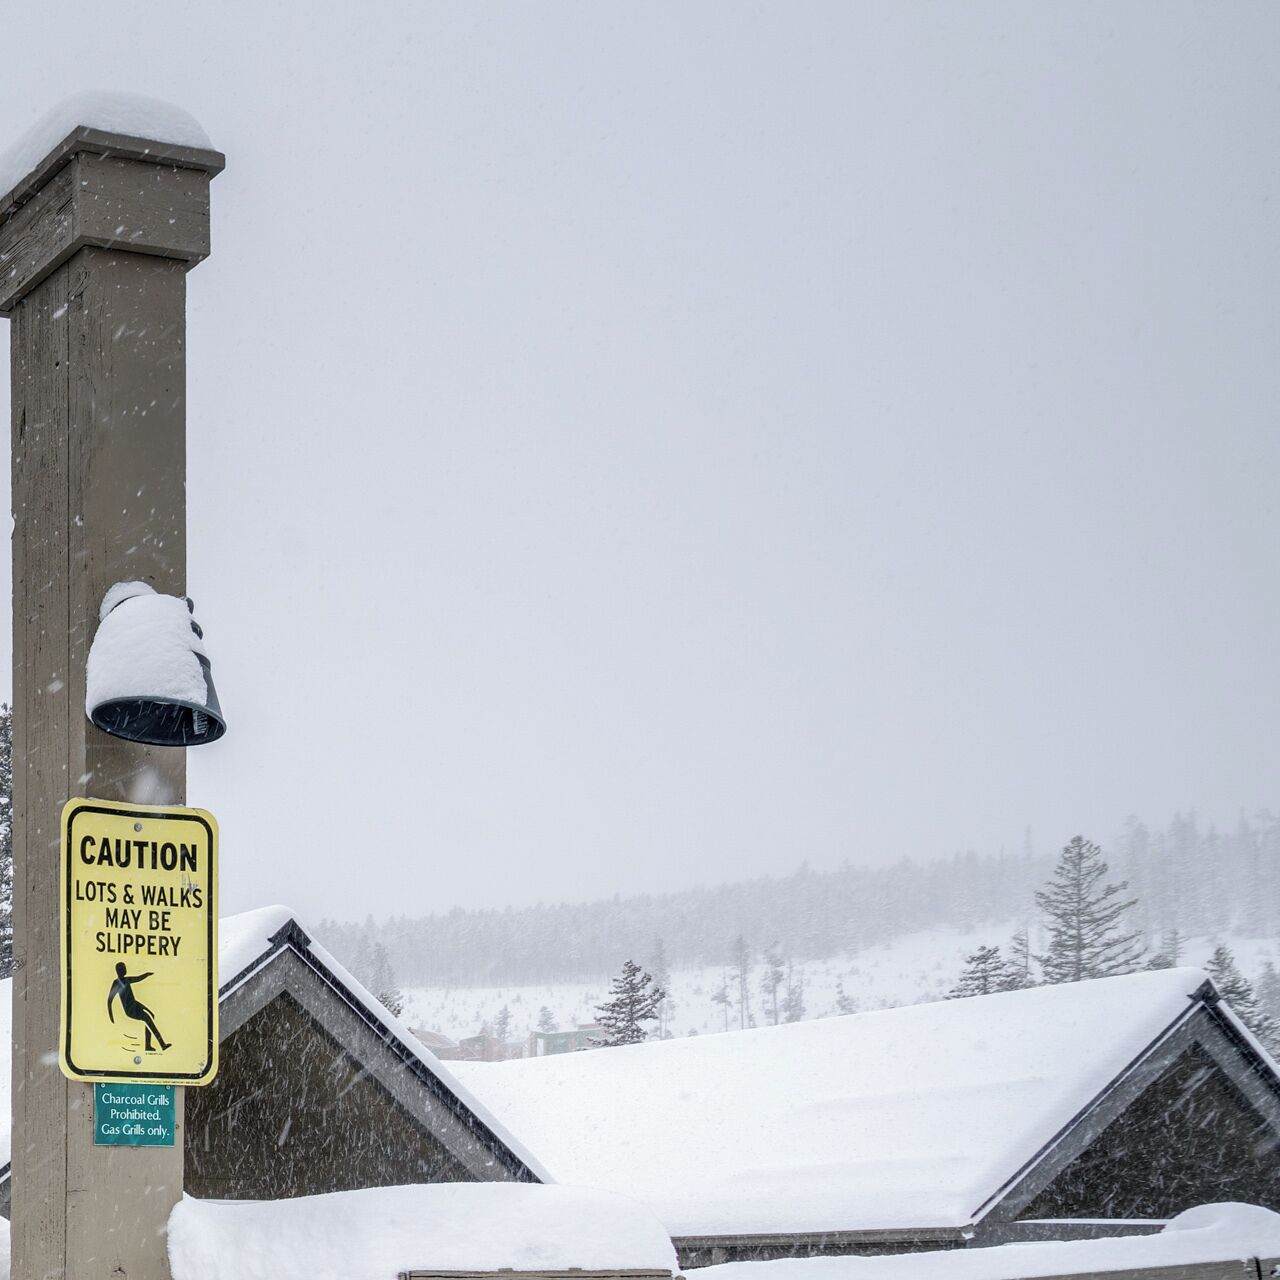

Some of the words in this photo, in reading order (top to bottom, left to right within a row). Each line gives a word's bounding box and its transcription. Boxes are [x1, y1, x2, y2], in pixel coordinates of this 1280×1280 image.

[80, 835, 197, 872] CAUTION
[76, 880, 117, 903] LOTS
[123, 884, 135, 905] &
[141, 885, 203, 908] WALKS
[105, 907, 142, 930] MAY
[149, 911, 172, 932] BE
[95, 931, 182, 957] SLIPPERY
[101, 1092, 145, 1105] Charcoal
[147, 1094, 170, 1106] Grills
[110, 1108, 162, 1121] Prohibited.
[101, 1123, 120, 1135] Gas
[122, 1123, 146, 1136] Grills
[147, 1124, 170, 1139] only.
